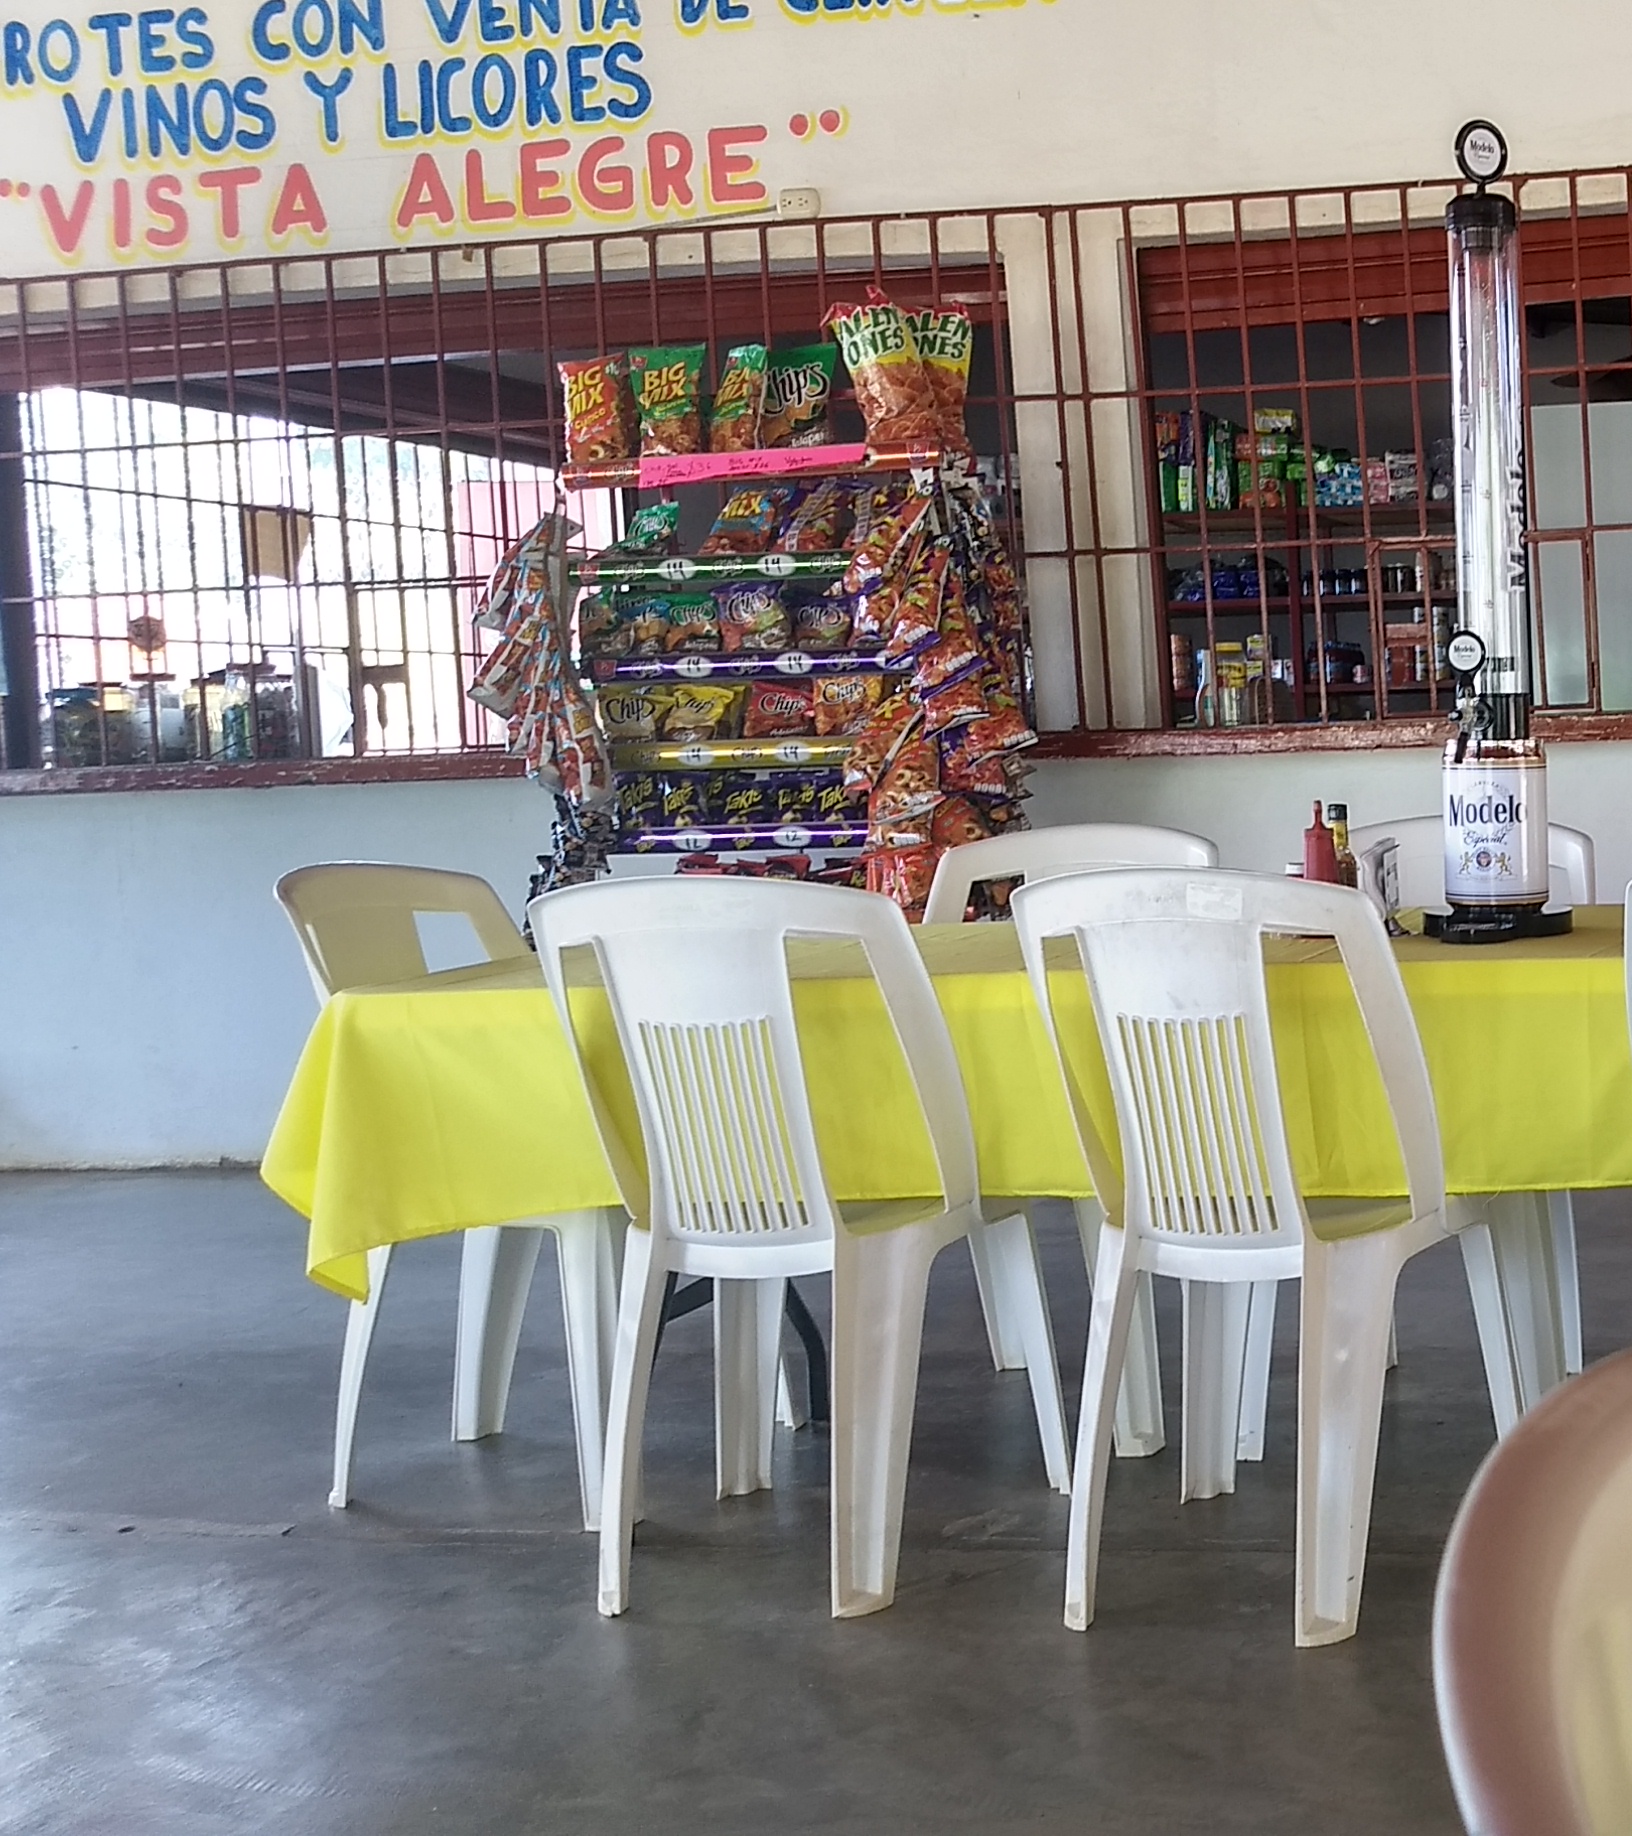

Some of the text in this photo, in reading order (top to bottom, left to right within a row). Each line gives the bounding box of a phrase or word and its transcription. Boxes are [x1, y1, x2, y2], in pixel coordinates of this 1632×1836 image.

[4, 8, 214, 85] ROTES
[252, 0, 385, 60] CON
[62, 41, 652, 163] VINOS Y LICORES
[567, 365, 602, 399] BIG
[643, 361, 686, 391] BIG
[640, 377, 686, 410] MIX
[765, 557, 782, 577] 14
[687, 658, 701, 673] 14
[788, 655, 803, 671] 14
[778, 784, 815, 811] Tais
[818, 785, 846, 812] Tak
[1449, 794, 1528, 826] Modelo
